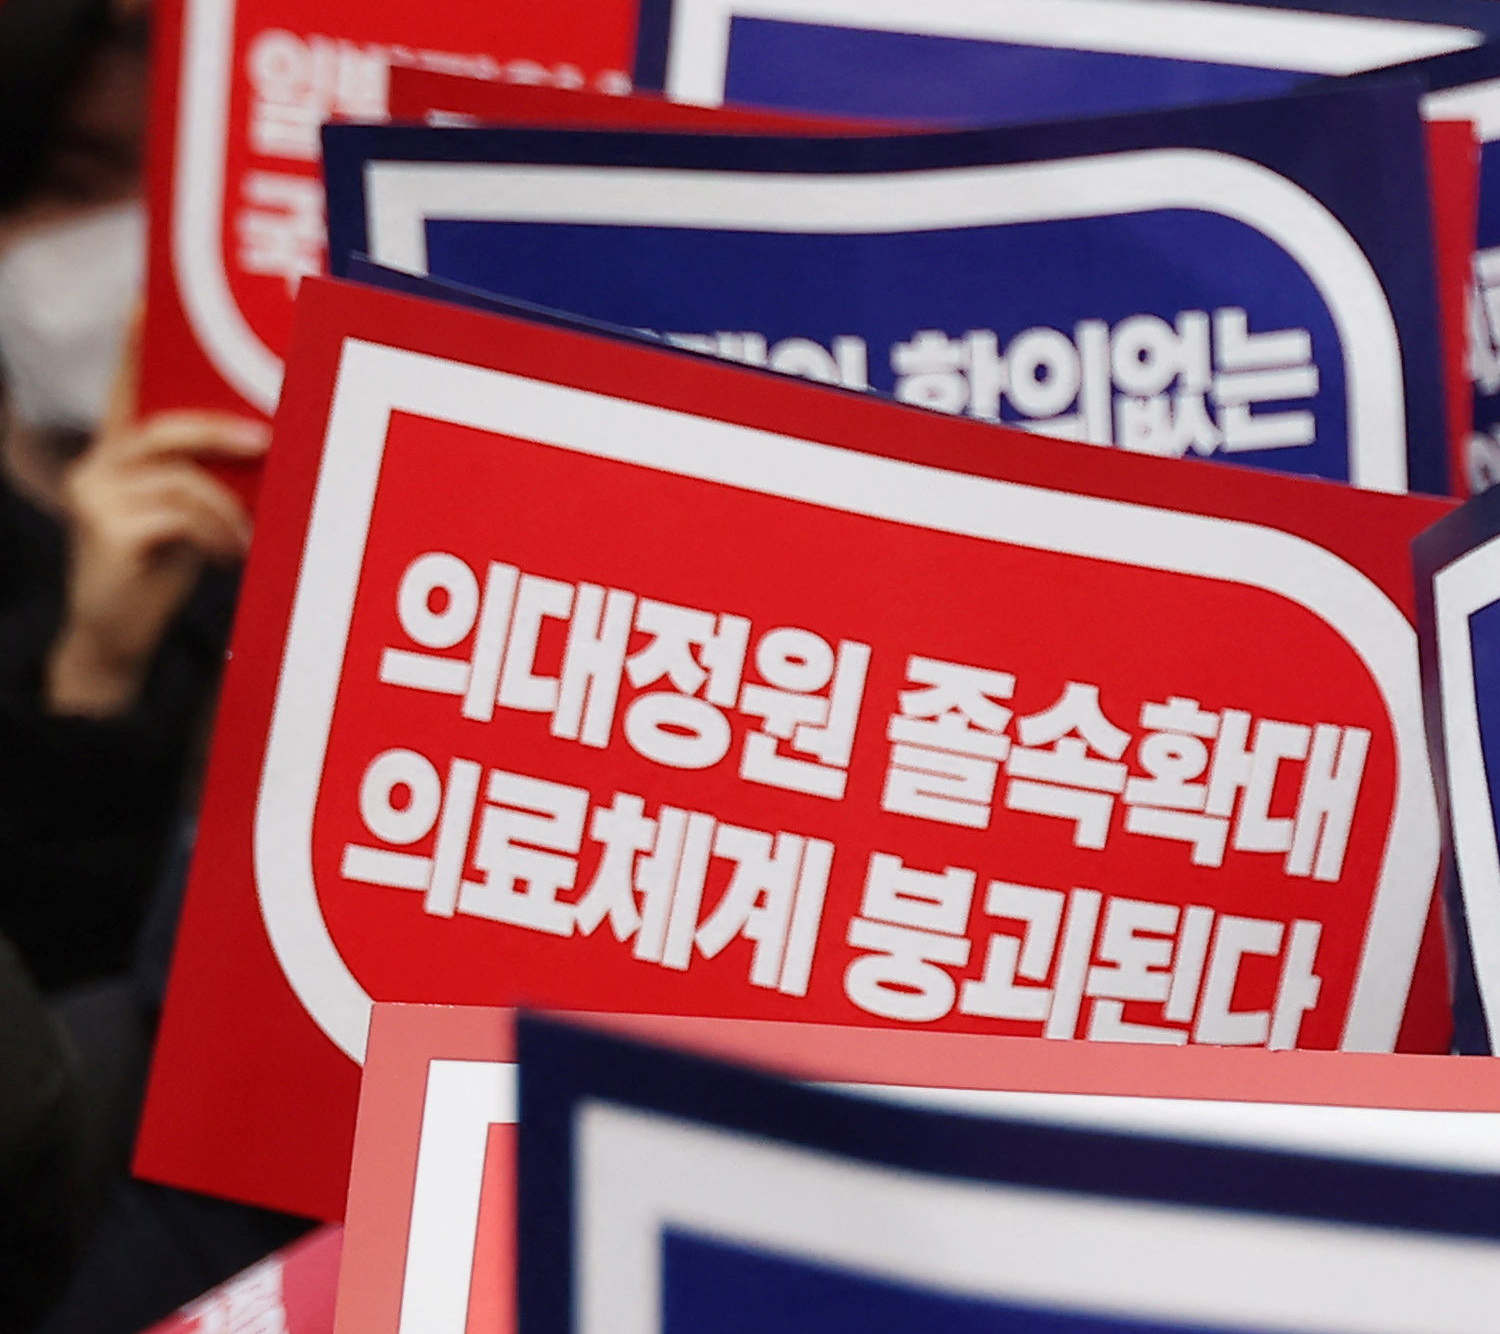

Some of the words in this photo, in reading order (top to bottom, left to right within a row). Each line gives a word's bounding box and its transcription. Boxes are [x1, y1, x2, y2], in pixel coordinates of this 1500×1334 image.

[381, 551, 870, 798] 의대정원
[880, 656, 1370, 882] 졸속확대
[340, 747, 835, 996] 의료체계
[845, 852, 1322, 1052] 붕괴된다
